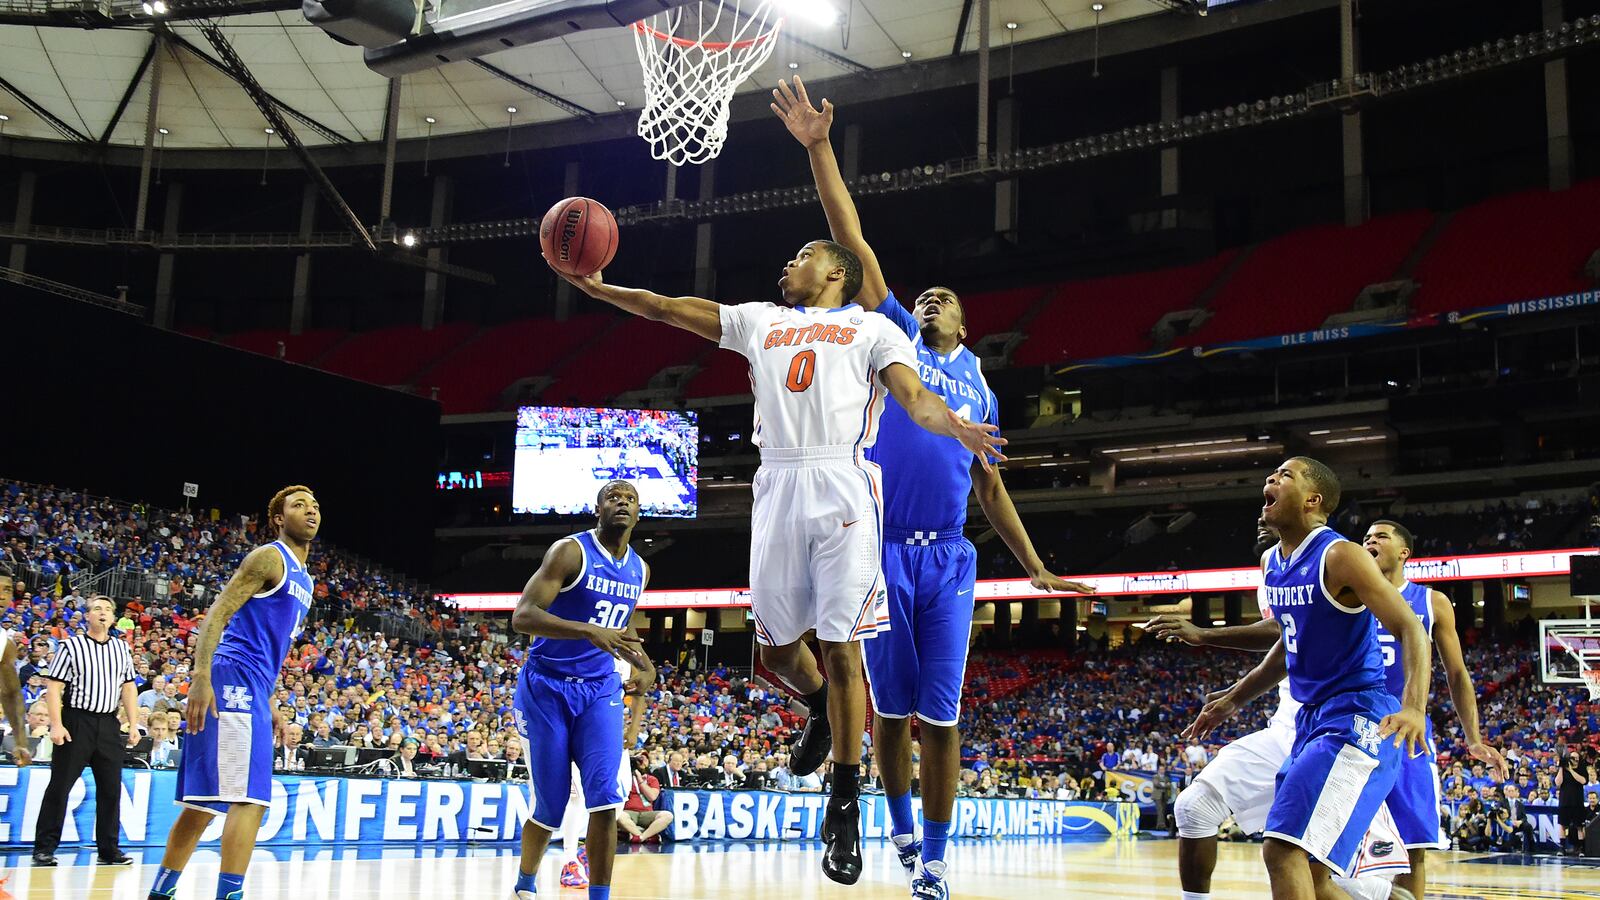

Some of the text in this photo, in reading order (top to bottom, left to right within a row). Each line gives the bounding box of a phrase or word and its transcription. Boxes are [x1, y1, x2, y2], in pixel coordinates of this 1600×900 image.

[560, 210, 583, 262] Wilson
[763, 323, 857, 350] GATORS
[1281, 327, 1349, 345] OLE MISS
[785, 349, 816, 393] 0
[588, 600, 630, 630] 30
[1281, 613, 1298, 654] 2
